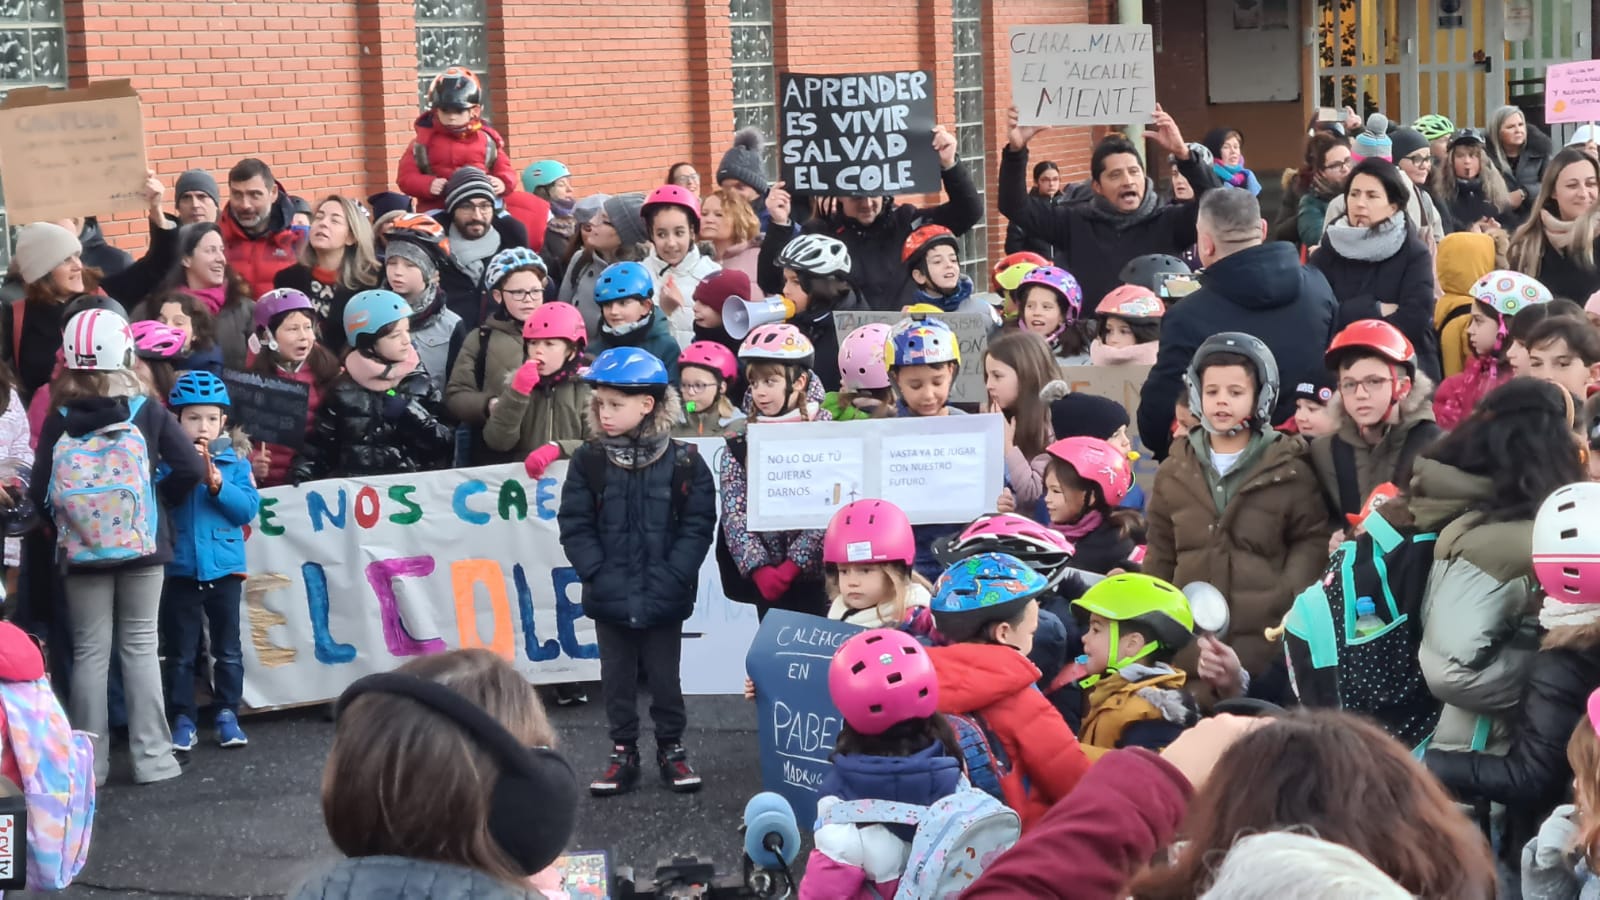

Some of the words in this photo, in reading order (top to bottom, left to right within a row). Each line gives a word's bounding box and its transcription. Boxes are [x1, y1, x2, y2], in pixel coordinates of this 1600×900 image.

[1021, 62, 1048, 82] EL
[783, 71, 927, 108] APRENDER
[1035, 86, 1149, 119] MIENTE
[786, 111, 817, 136] ES
[831, 105, 910, 134] VIVIR
[782, 133, 907, 164] SALVAD
[794, 165, 829, 190] EL
[835, 160, 915, 191] COLE
[767, 454, 784, 464] NO
[786, 454, 800, 464] LO
[802, 453, 825, 463] QUE
[890, 449, 917, 458] VASTA
[934, 448, 945, 456] DE
[948, 447, 976, 456] JUGAR
[767, 470, 812, 481] QUIERAS
[889, 463, 909, 472] CON
[911, 462, 952, 471] NUESTRO
[243, 497, 286, 542] E
[306, 485, 424, 533] NOS
[451, 478, 558, 526] CAE
[246, 561, 357, 668] EL
[364, 555, 601, 664] COLE
[776, 626, 848, 648] CALEFACC
[788, 663, 810, 680] EN
[773, 701, 844, 752] PABE
[783, 760, 823, 785] MADRUG
